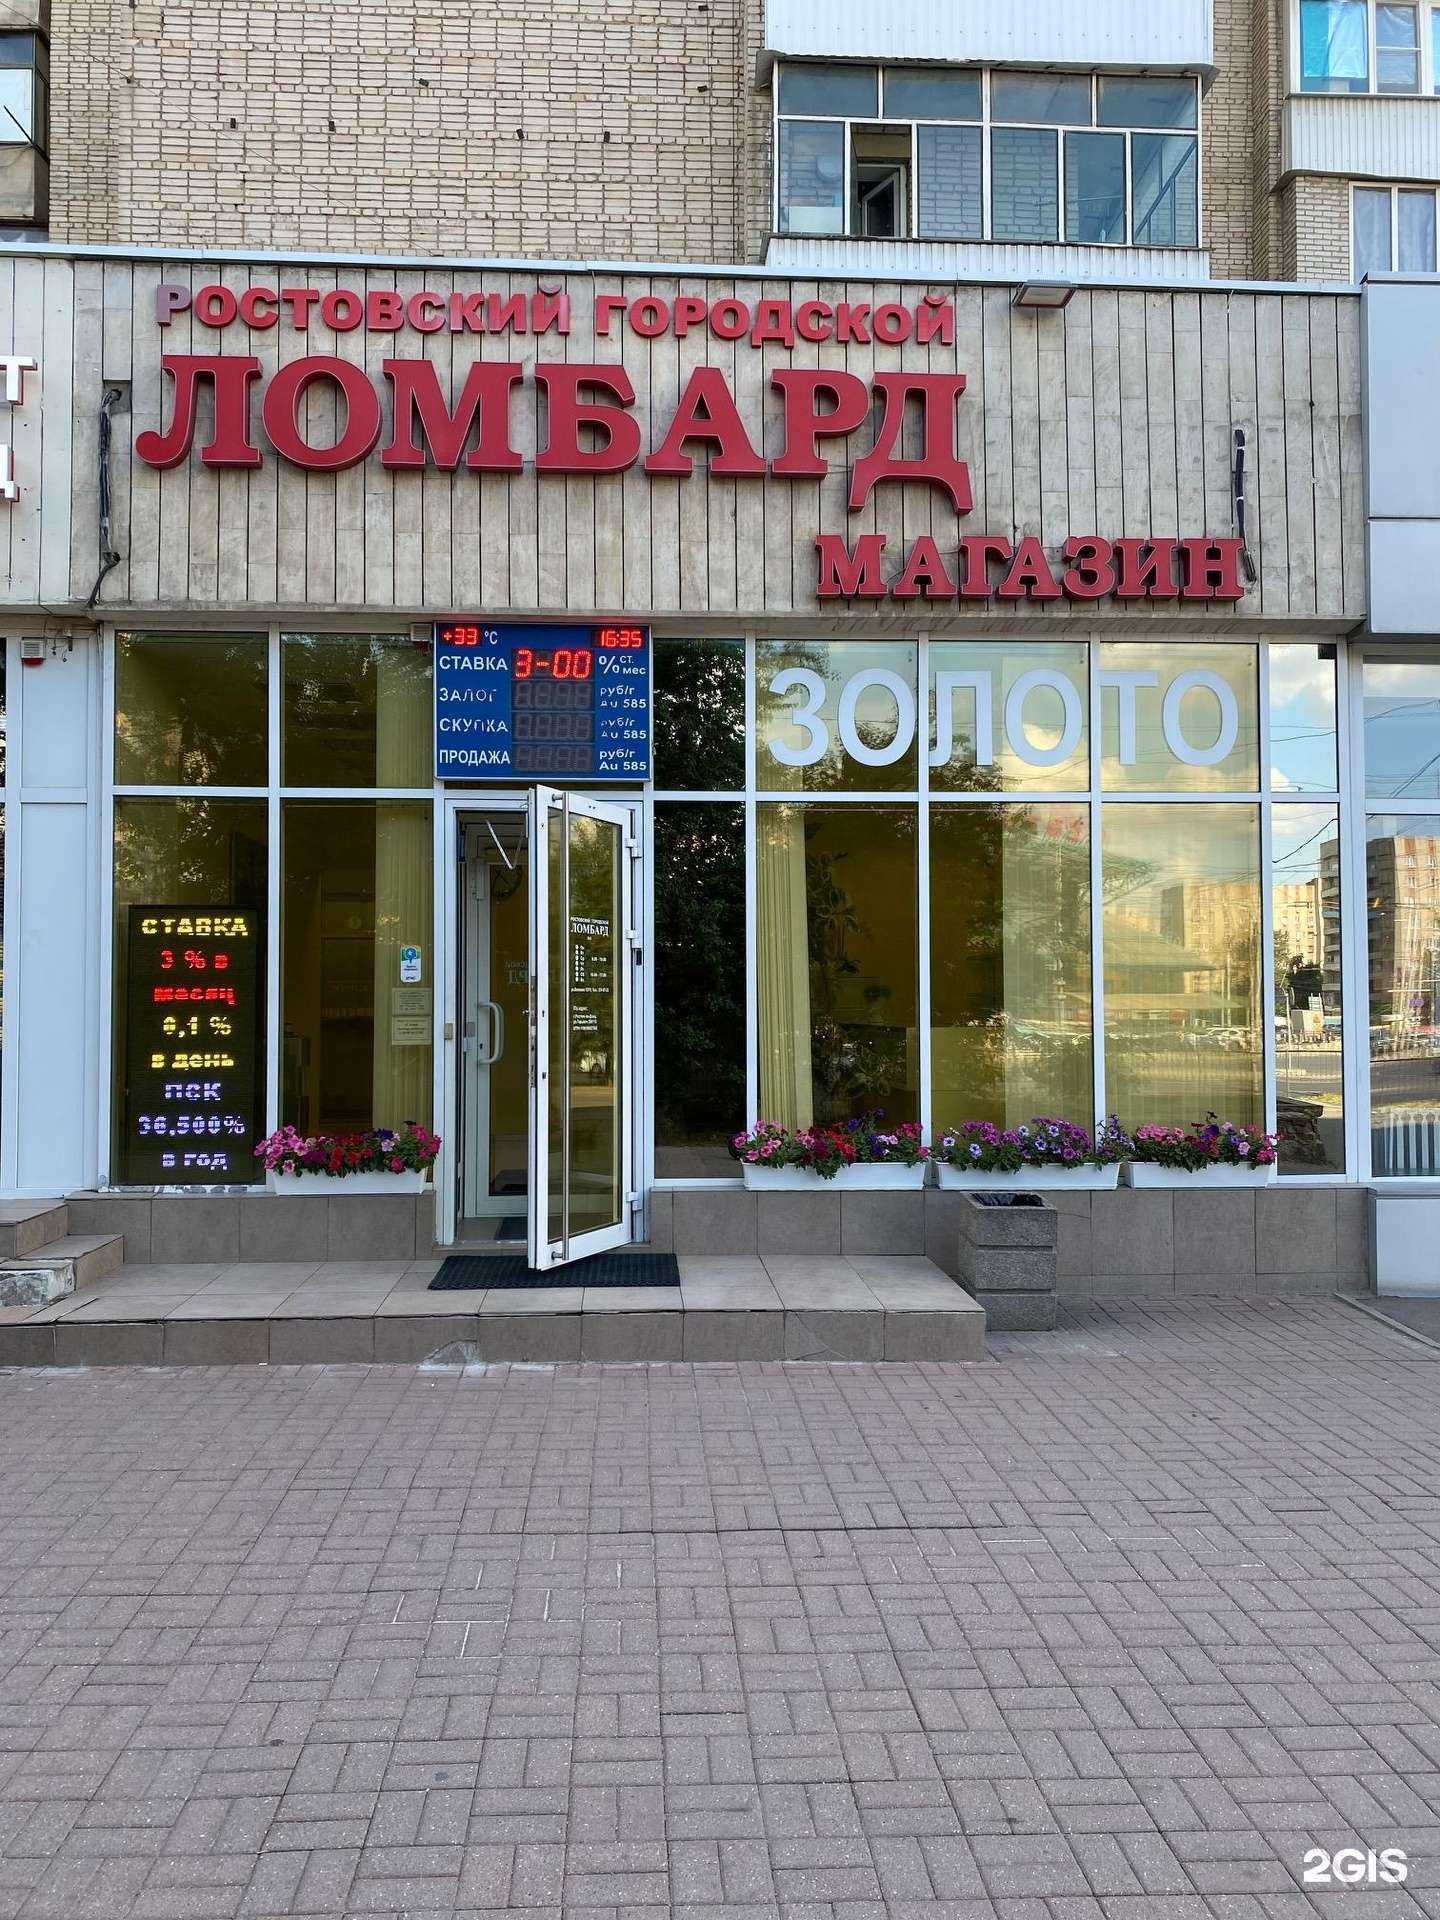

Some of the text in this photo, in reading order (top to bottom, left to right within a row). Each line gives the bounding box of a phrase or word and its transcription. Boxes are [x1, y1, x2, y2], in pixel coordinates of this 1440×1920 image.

[156, 282, 955, 348] РОСТОВСКИЙ ГОРОДСКОЙ
[135, 354, 974, 516] ЛОМБАРД
[814, 534, 1245, 601] МАГАЗИН
[443, 628, 478, 645] +33
[601, 630, 642, 647] 16:35
[439, 655, 508, 671] СТАВКА
[622, 667, 647, 675] мес
[623, 699, 647, 709] 585
[768, 667, 1240, 768] ЗОЛОТО
[623, 729, 647, 739] 585
[439, 748, 511, 766] ПРОДАЖА
[599, 748, 636, 760] руб/г
[599, 760, 647, 771] Au 585
[141, 917, 249, 937] СТАВКА
[570, 922, 609, 937] ЛОМБАРД
[160, 950, 174, 969] 3
[164, 1083, 222, 1100] ПСК
